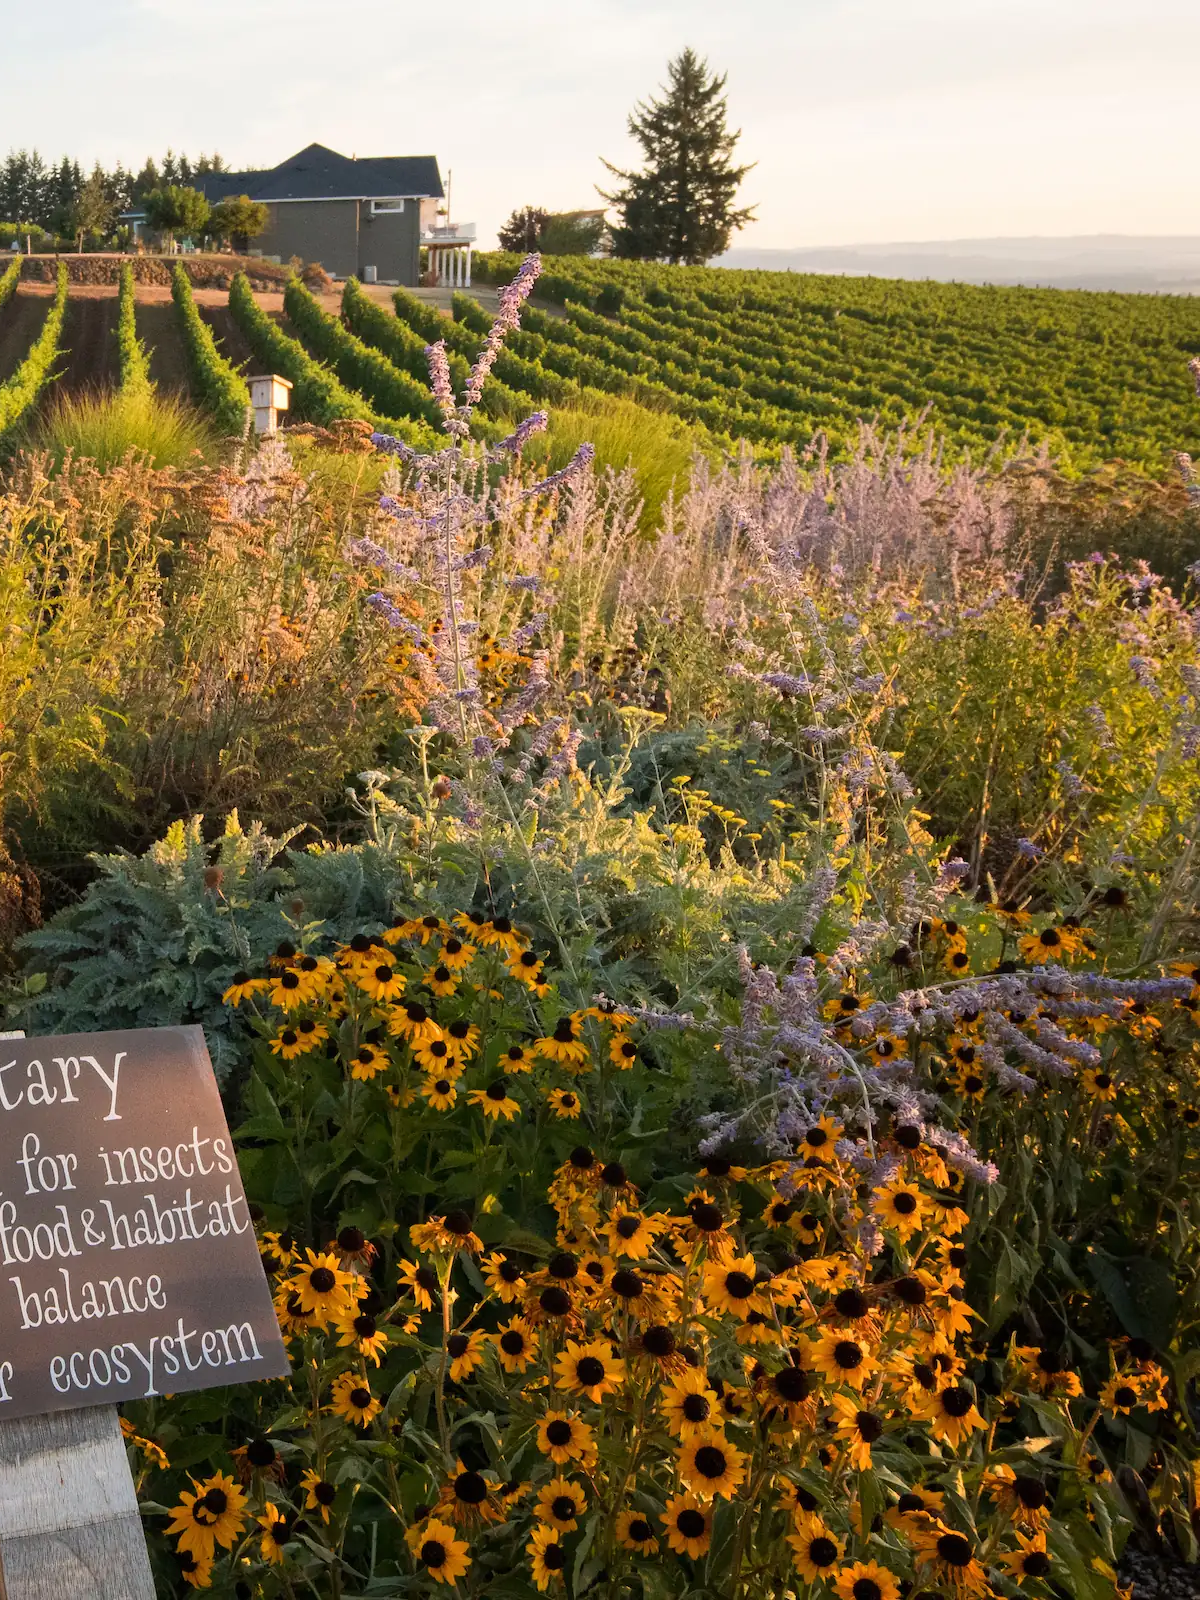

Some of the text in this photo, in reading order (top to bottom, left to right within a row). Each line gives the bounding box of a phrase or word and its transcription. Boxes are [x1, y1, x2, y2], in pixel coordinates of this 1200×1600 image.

[16, 1133, 80, 1196] for
[98, 1126, 233, 1186] insects
[9, 1268, 167, 1330] balance
[49, 1318, 263, 1396] ecosystem
